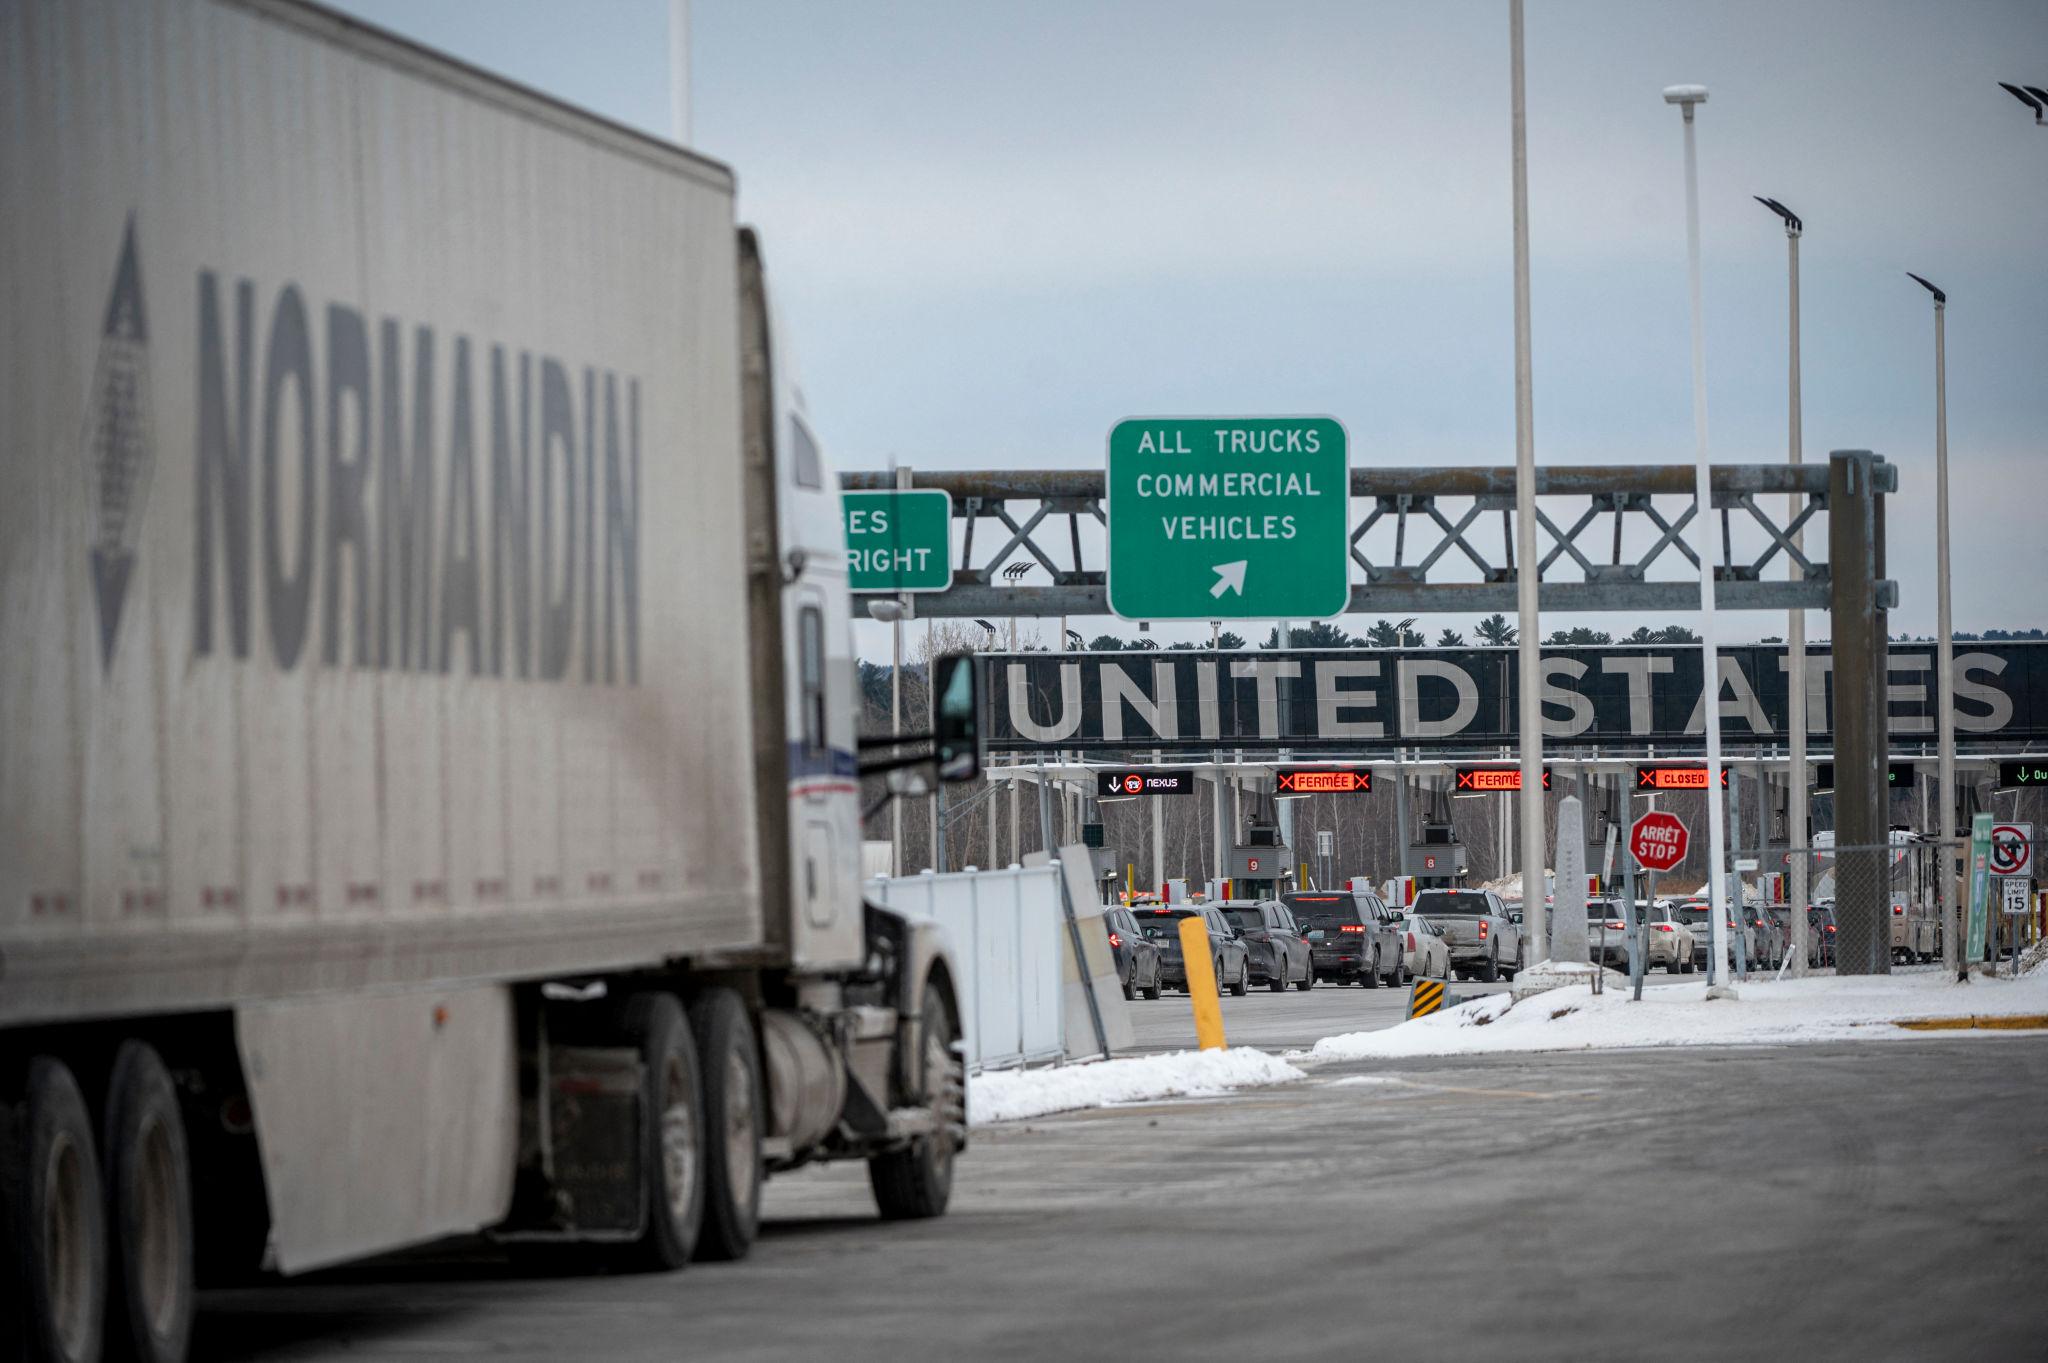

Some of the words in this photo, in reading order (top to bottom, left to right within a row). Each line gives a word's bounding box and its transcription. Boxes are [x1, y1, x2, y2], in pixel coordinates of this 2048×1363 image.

[1138, 431, 1190, 453] ALL
[1216, 429, 1321, 453] TRUCKS
[196, 268, 640, 684] NORMANDIN
[1137, 472, 1321, 497] COMMERCIAL
[1163, 515, 1296, 539] VEHICLES
[846, 548, 931, 572] RIGHT
[1007, 658, 1479, 744] UNITED
[1540, 652, 2015, 738] STATES
[1146, 778, 1178, 788] NEXUS
[1298, 773, 1349, 788] FERMÉE
[1477, 771, 1521, 786] FERMÉ
[1664, 774, 1705, 784] CLOSED
[1639, 825, 1680, 844] ARRÊT
[1638, 842, 1677, 860] STOP
[1250, 861, 1258, 871] 9
[1427, 859, 1435, 868] 8
[2008, 897, 2025, 910] 15
